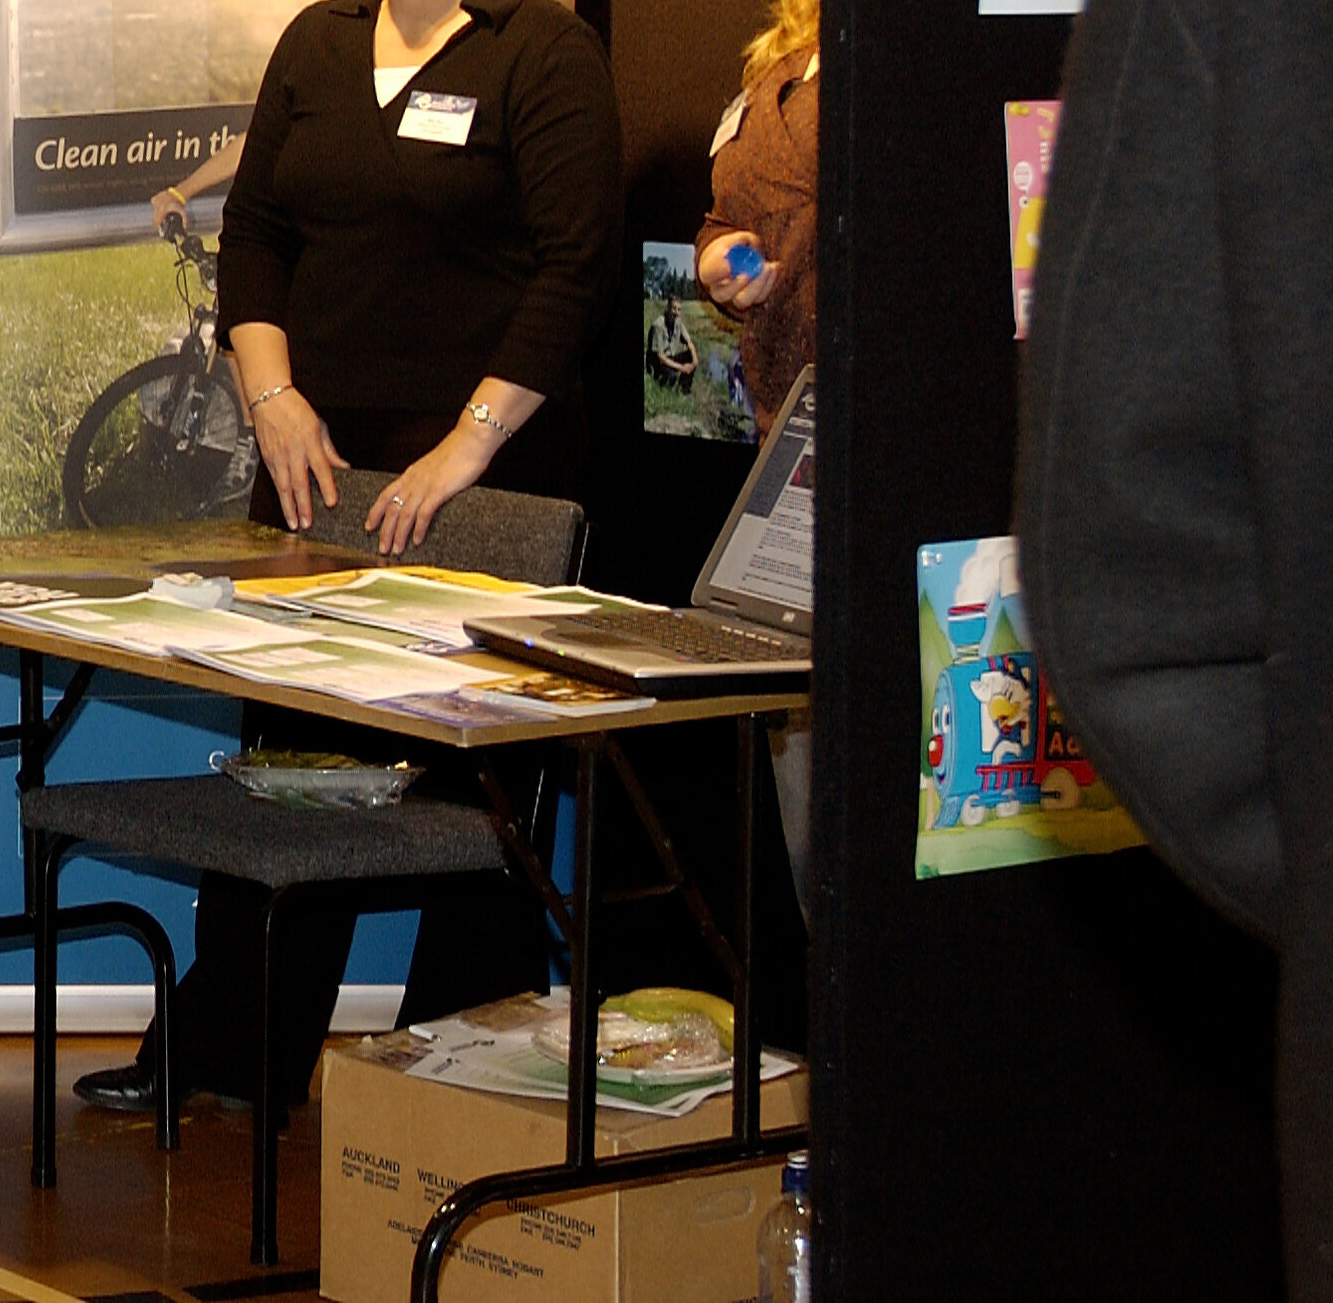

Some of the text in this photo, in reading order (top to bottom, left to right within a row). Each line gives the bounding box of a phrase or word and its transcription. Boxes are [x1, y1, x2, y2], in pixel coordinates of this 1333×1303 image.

[35, 137, 117, 170] Clean
[126, 130, 168, 165] air
[174, 129, 201, 160] in
[342, 1145, 401, 1174] AUCKLAND
[506, 1199, 596, 1238] CHRISTCHURCH
